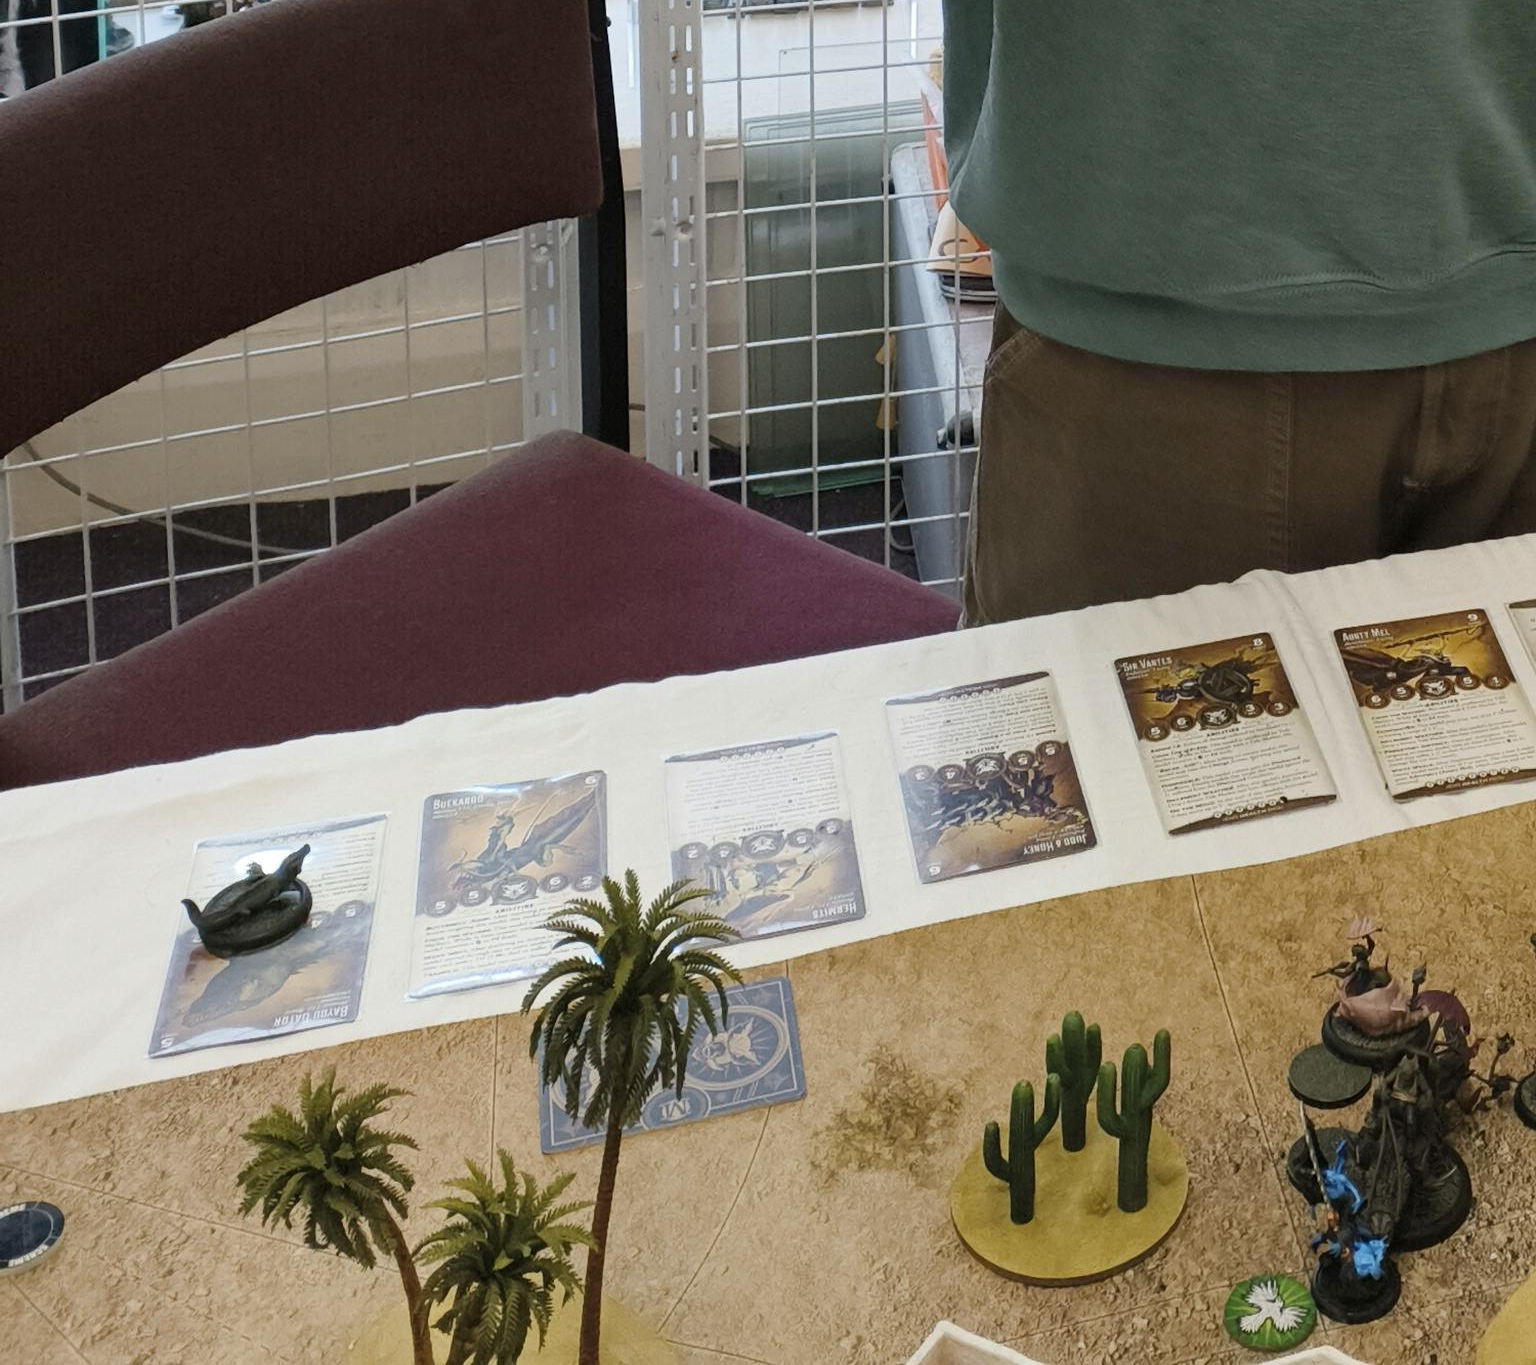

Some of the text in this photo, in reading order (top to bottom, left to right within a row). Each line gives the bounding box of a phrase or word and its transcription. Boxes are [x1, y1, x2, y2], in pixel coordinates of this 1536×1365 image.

[1342, 630, 1370, 643] AUNTY
[1371, 627, 1391, 638] MEL
[1122, 656, 1173, 673] SIR VANTES
[585, 775, 597, 785] 6
[433, 794, 484, 811] BUCKAROO
[687, 850, 699, 859] 2
[1023, 840, 1054, 855] HONEY
[928, 865, 942, 876] 6
[434, 900, 447, 910] 5
[582, 875, 594, 885] 2
[812, 902, 857, 919] HERMITS
[312, 1005, 350, 1018] BAYOU
[160, 1036, 174, 1049] 5
